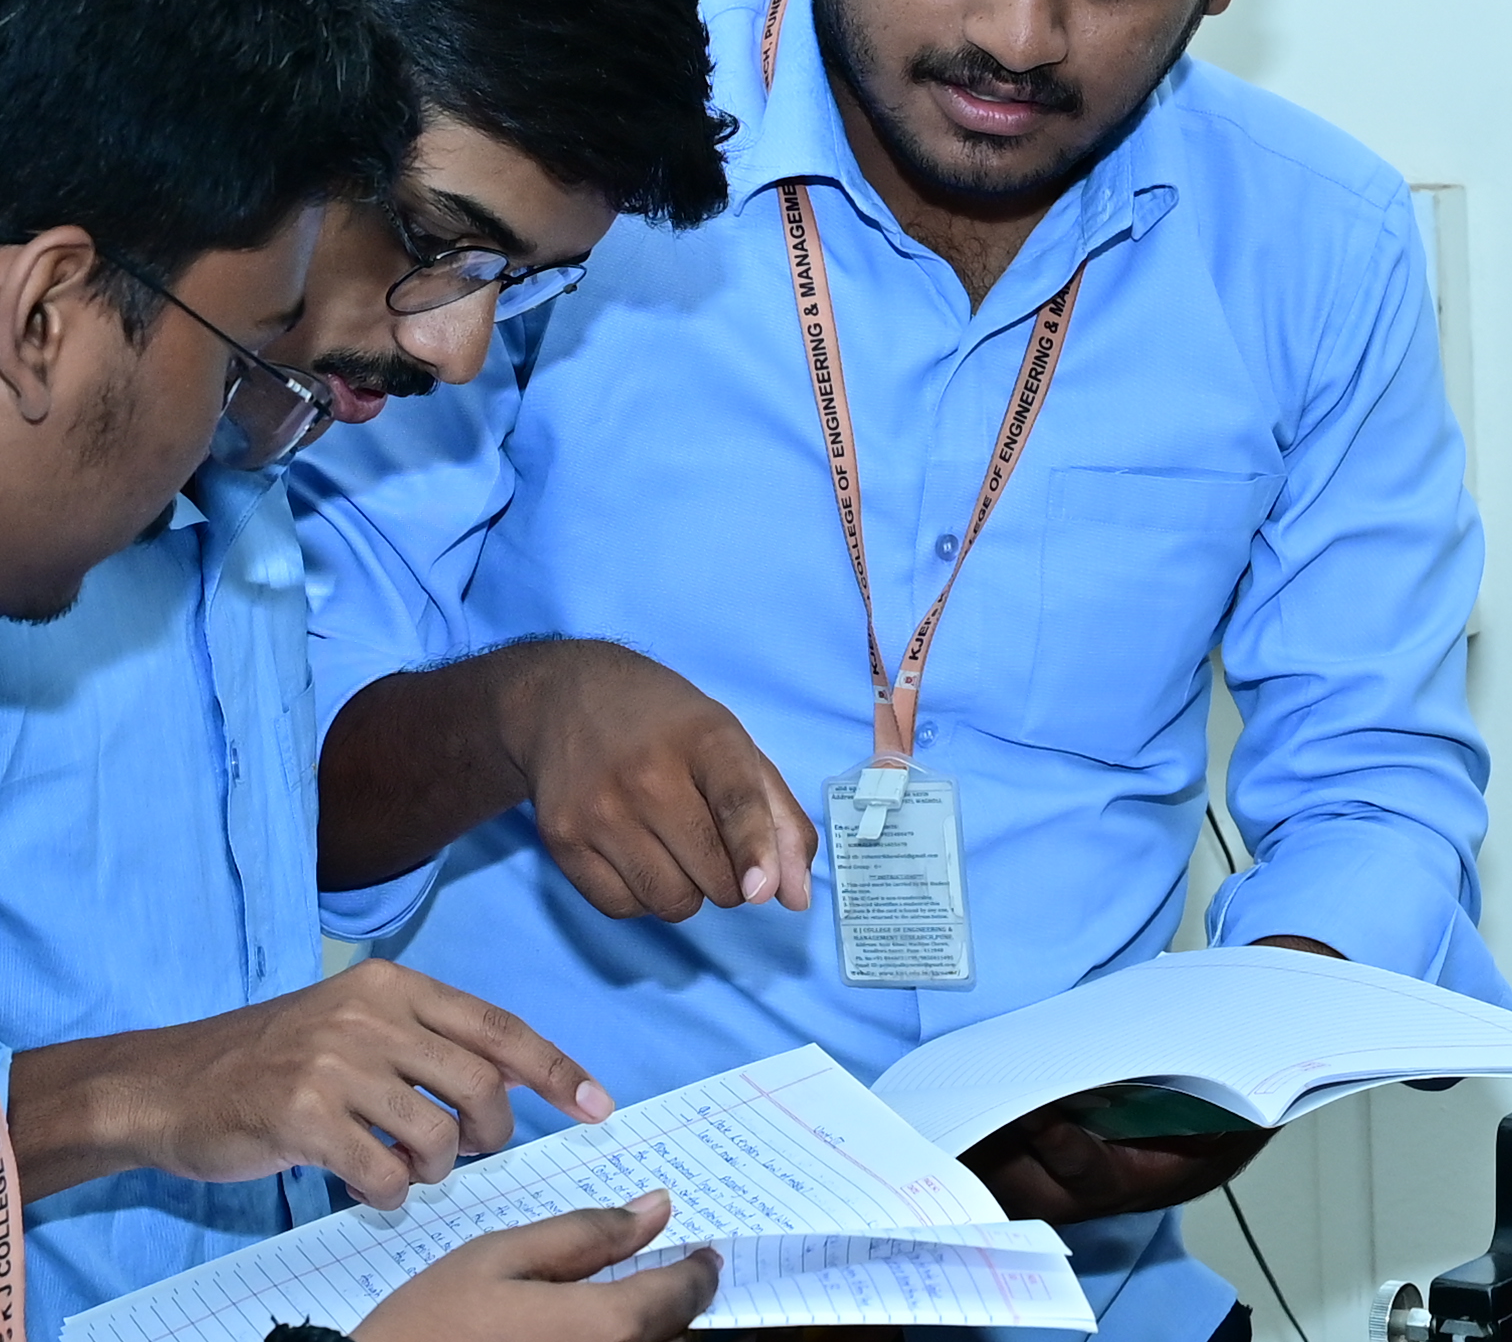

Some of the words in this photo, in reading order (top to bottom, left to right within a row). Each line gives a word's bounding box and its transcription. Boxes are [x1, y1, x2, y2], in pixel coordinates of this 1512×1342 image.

[780, 183, 817, 298] MANAGEME
[803, 302, 820, 317] &
[807, 322, 845, 460] ENGINEERING
[989, 464, 1003, 493] OF
[998, 335, 1054, 464] ENGINEERING
[1043, 320, 1060, 335] &
[835, 464, 850, 493] OF
